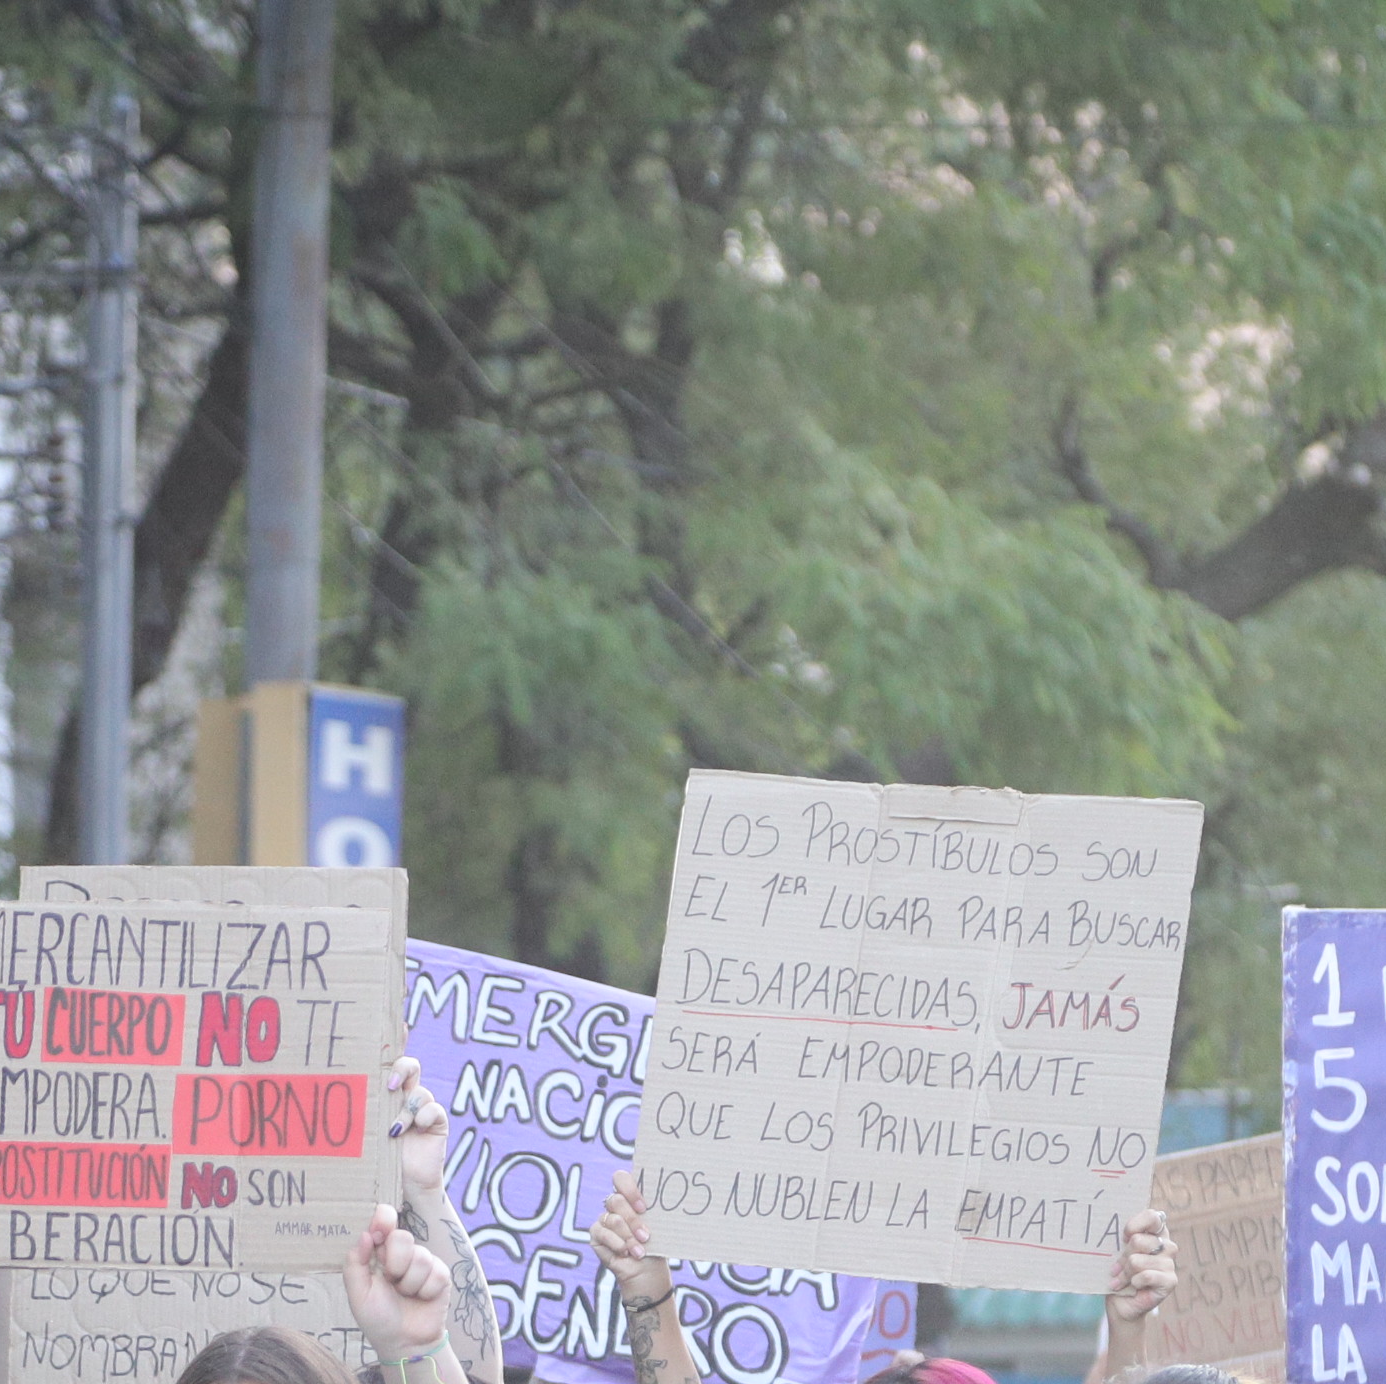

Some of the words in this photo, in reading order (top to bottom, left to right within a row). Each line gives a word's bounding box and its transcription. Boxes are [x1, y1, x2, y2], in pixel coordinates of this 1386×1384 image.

[692, 794, 779, 858] LOS
[803, 801, 1058, 877] PROSTÍBULOS
[1082, 840, 1157, 881] SON
[684, 874, 728, 921] EL
[820, 885, 932, 938] LUGAR
[959, 896, 1049, 948] PARA
[1069, 900, 1183, 953] BUSCAR
[406, 958, 653, 1083] MERG
[676, 948, 981, 1034] DESAPARECIDAS,
[1003, 973, 1141, 1033] JAMÁS
[1312, 943, 1356, 1027] 1
[46, 986, 172, 1056] CUERPO
[195, 991, 281, 1067] NO
[297, 1000, 353, 1068] TE
[661, 1026, 758, 1076] SERÁ
[799, 1036, 1094, 1098] EMPODERANTE
[190, 1075, 353, 1149] PORNO
[656, 1091, 732, 1140] QUE
[761, 1101, 833, 1151] LOS
[858, 1102, 1069, 1165] PRIVILEGIOS
[1087, 1126, 1146, 1170] NO
[1311, 1047, 1368, 1133] 5
[180, 1161, 238, 1210] NO
[248, 1168, 306, 1208] SON
[636, 1167, 712, 1214] NOS
[724, 1171, 875, 1224] NUBLEN
[886, 1186, 929, 1230] LA
[954, 1190, 1121, 1251] EMPATÍA
[31, 1269, 77, 1301] LO
[88, 1269, 176, 1304] QUE
[193, 1271, 242, 1301] NO
[249, 1271, 309, 1305] SE
